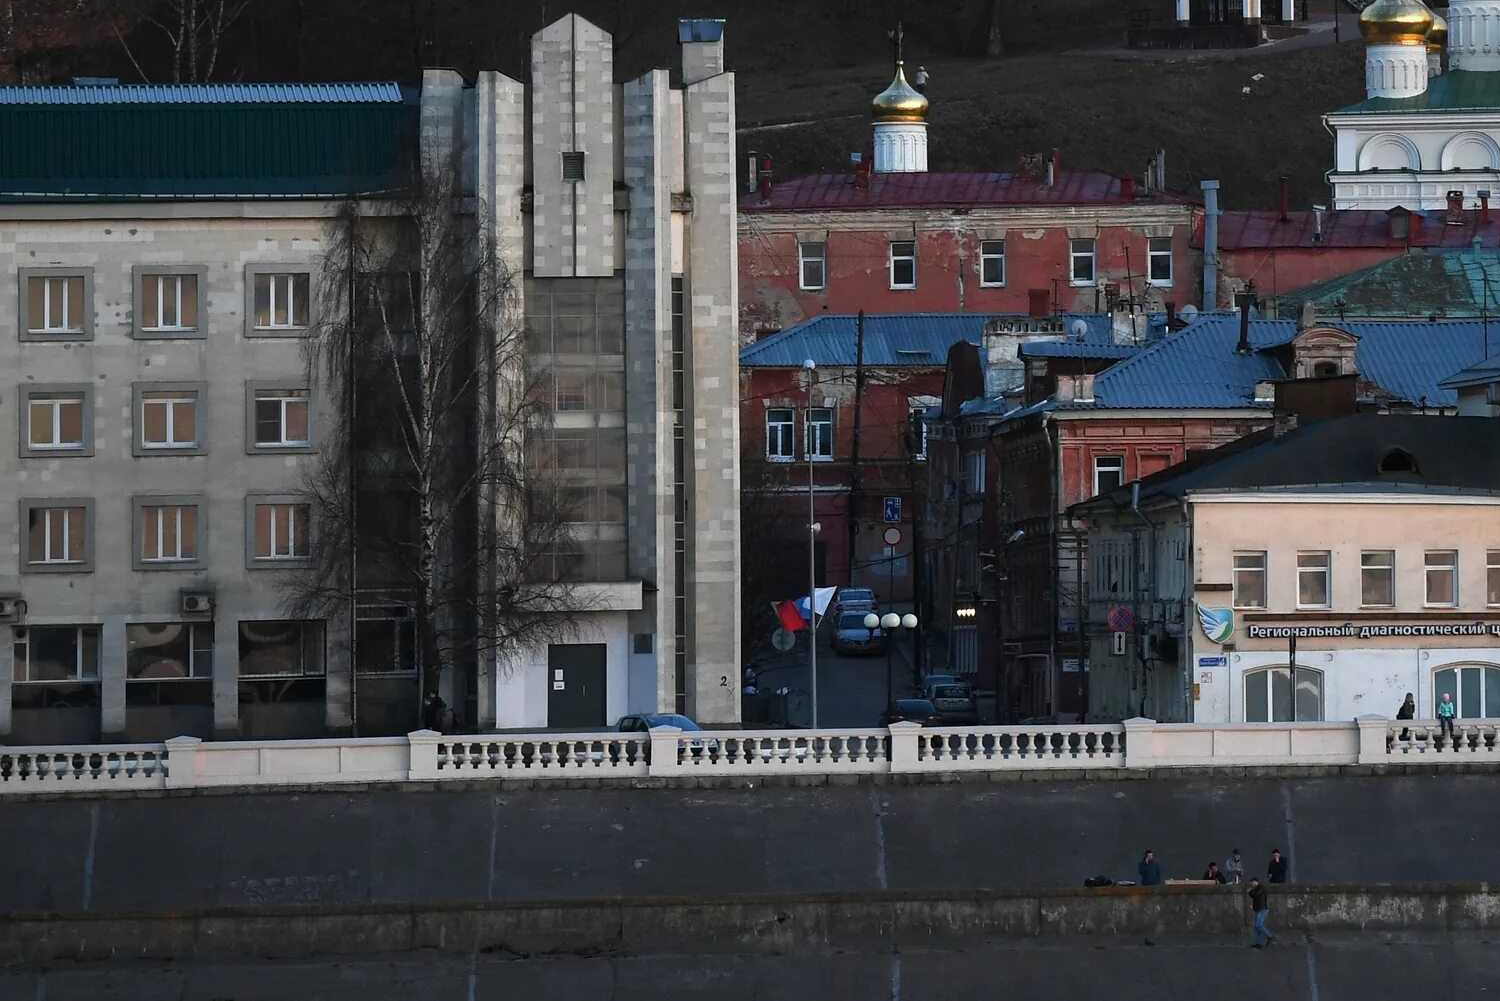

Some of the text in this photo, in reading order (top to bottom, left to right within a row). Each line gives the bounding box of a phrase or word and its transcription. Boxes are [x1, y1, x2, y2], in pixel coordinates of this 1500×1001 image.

[1249, 623, 1354, 637] Региональный
[1360, 623, 1486, 638] диагностический
[719, 675, 728, 687] 2
